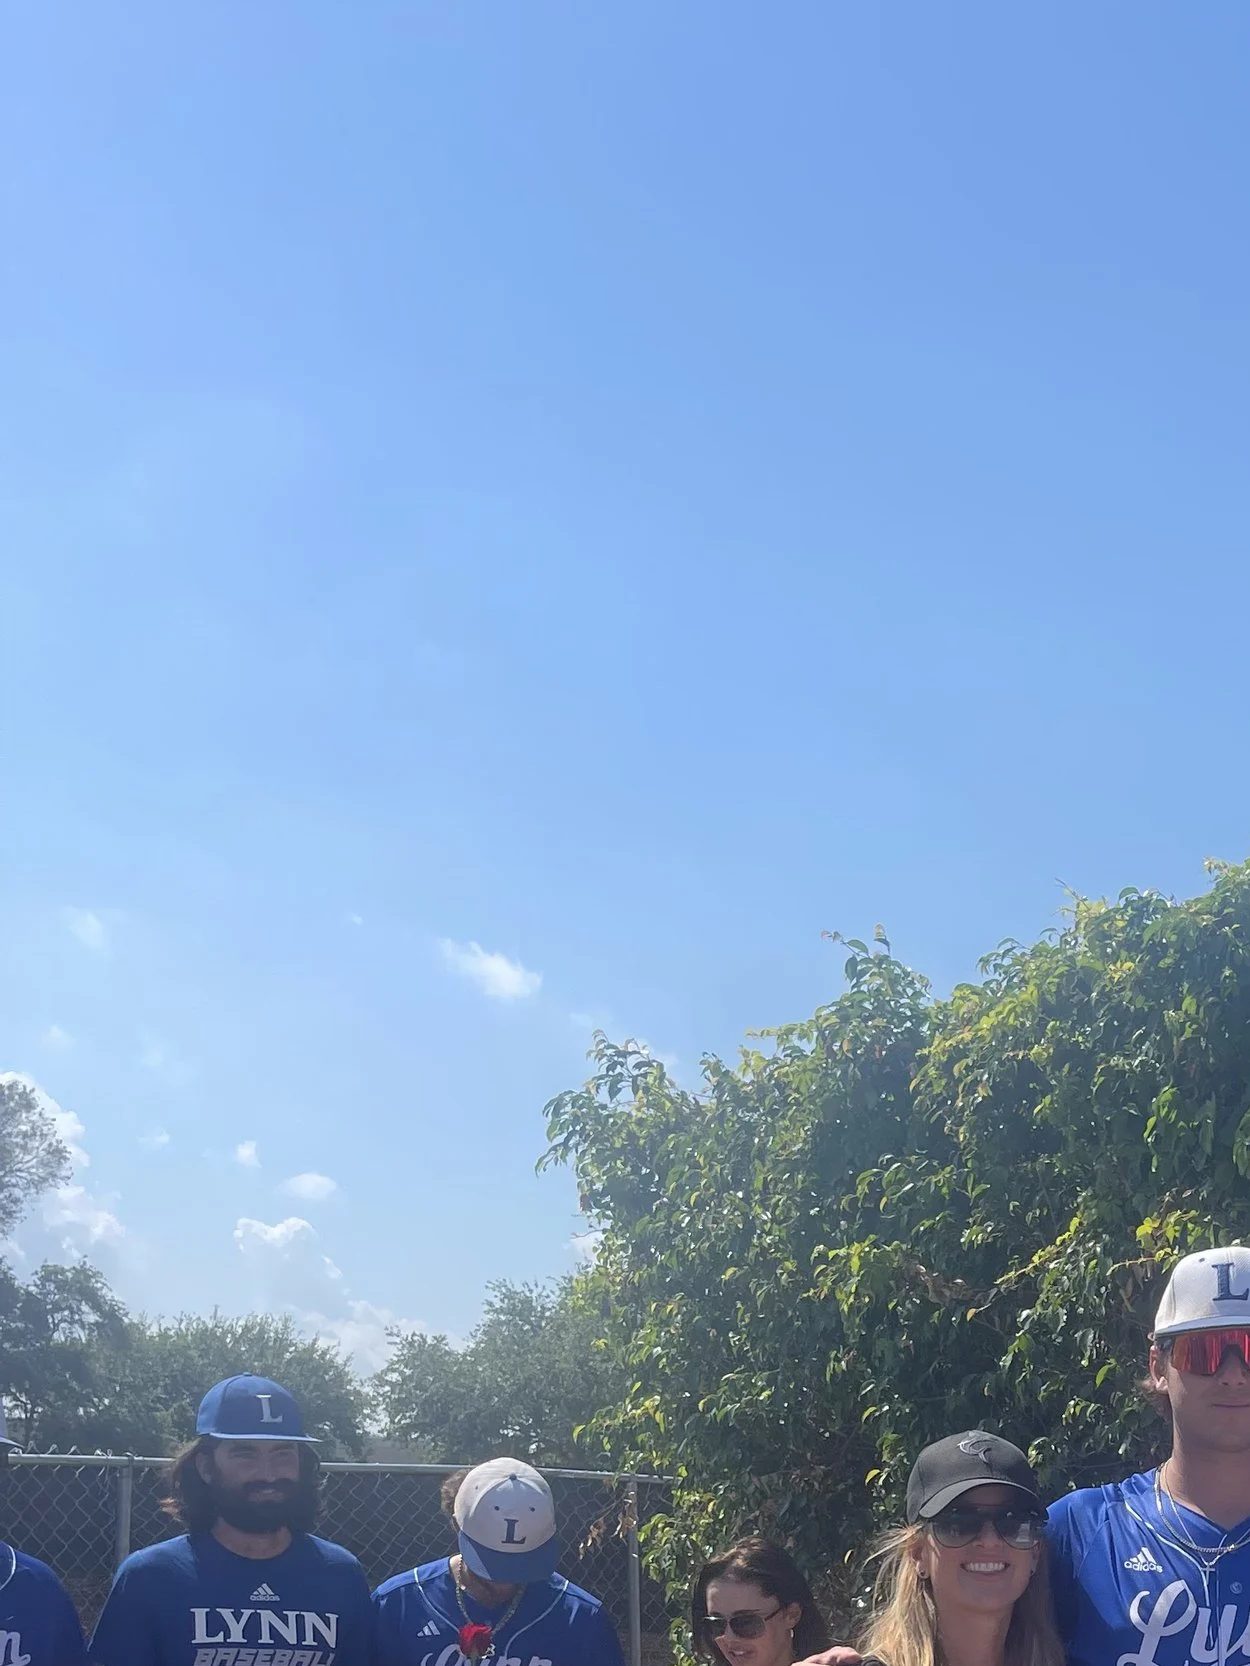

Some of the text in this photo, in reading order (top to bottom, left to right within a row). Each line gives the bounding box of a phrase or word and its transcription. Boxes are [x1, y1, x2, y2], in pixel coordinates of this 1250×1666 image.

[1211, 1262, 1250, 1301] L
[256, 1394, 283, 1423] L
[501, 1518, 526, 1545] L
[1123, 1560, 1163, 1573] adidas
[189, 1607, 340, 1648] LYNN
